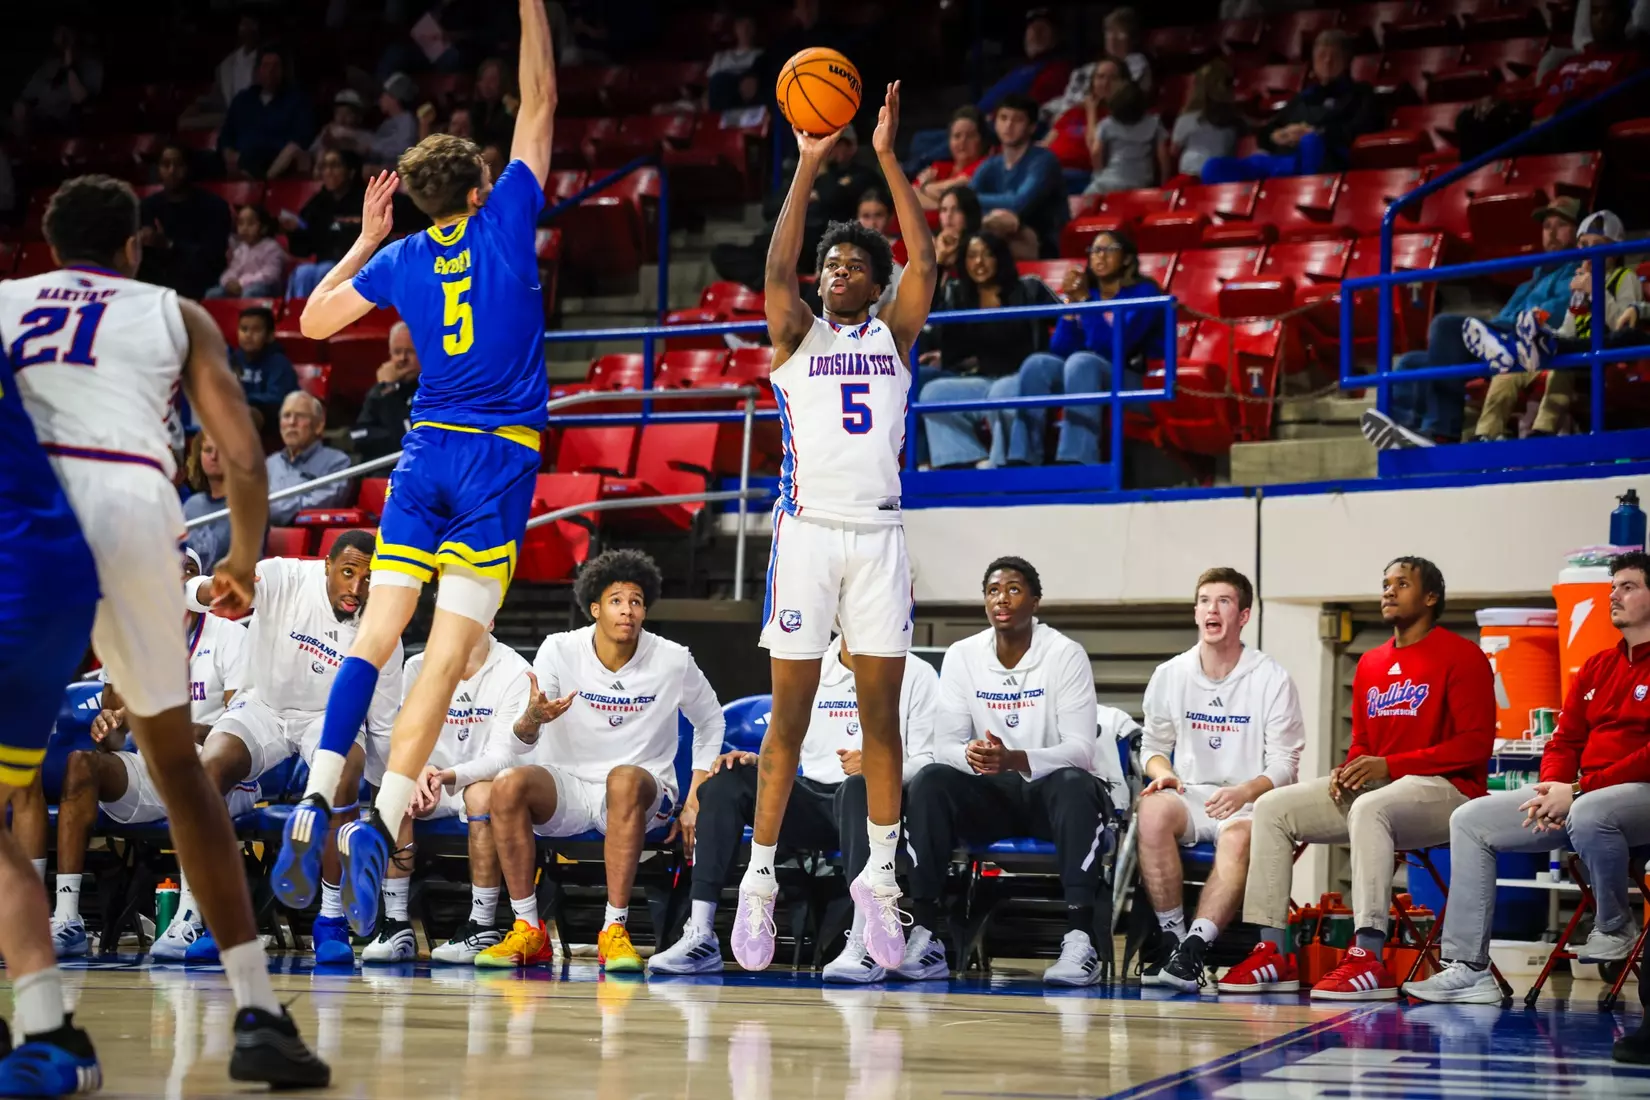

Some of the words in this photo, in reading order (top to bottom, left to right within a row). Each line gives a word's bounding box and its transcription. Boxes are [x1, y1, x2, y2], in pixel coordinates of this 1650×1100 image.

[441, 276, 474, 356] 5
[10, 301, 108, 372] 21
[808, 353, 870, 377] LOUISIANA
[869, 355, 896, 376] TECH
[840, 383, 873, 435] 5
[289, 631, 337, 658] LOUISIANA
[298, 643, 342, 669] BASKETBA
[579, 690, 631, 705] LOUISIANA
[633, 694, 657, 704] TECH
[976, 690, 1021, 701] LOUISIANA
[1023, 688, 1045, 699] TECH
[1367, 679, 1429, 719] Bulldog
[475, 707, 494, 716] TECH
[590, 702, 645, 712] BASKETBALL
[817, 701, 858, 709] LOUISIAN
[987, 700, 1035, 710] BASKETBALL
[829, 710, 859, 718] BASKET
[1229, 716, 1251, 724] TECH
[1191, 722, 1240, 733] BASKETBALL
